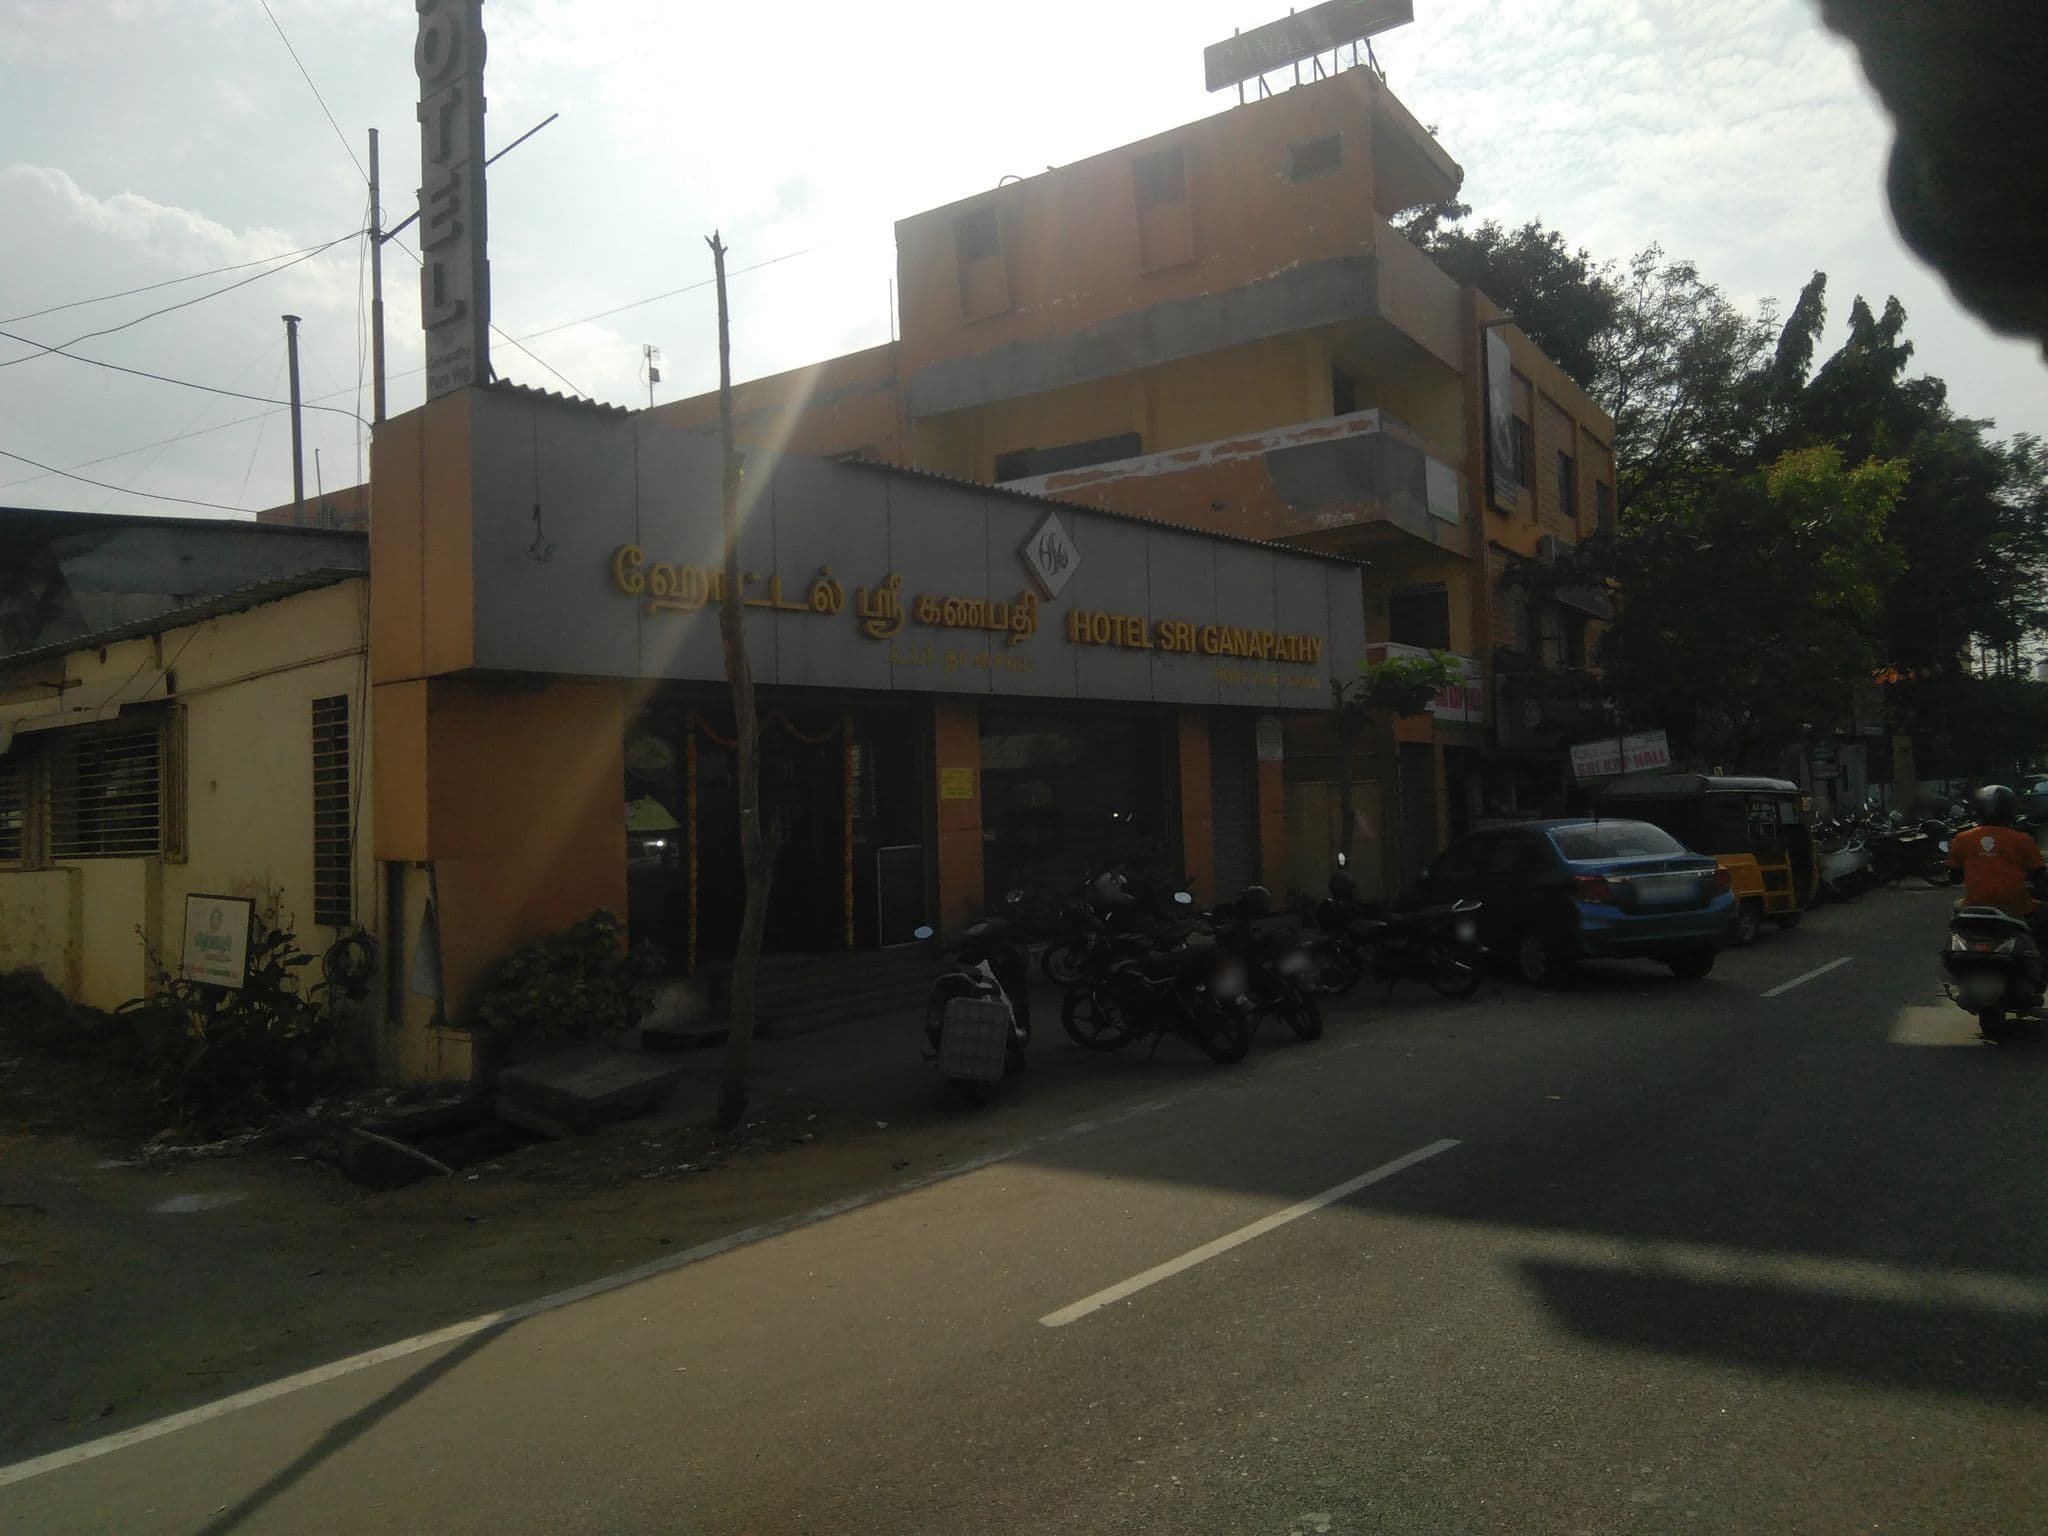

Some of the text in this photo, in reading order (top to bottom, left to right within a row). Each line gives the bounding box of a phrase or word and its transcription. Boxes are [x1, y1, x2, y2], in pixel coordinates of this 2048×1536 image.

[415, 0, 470, 331] OTEL
[914, 590, 1039, 647] கணபதி
[1066, 608, 1322, 664] HOTEL SRI GANAPATHY
